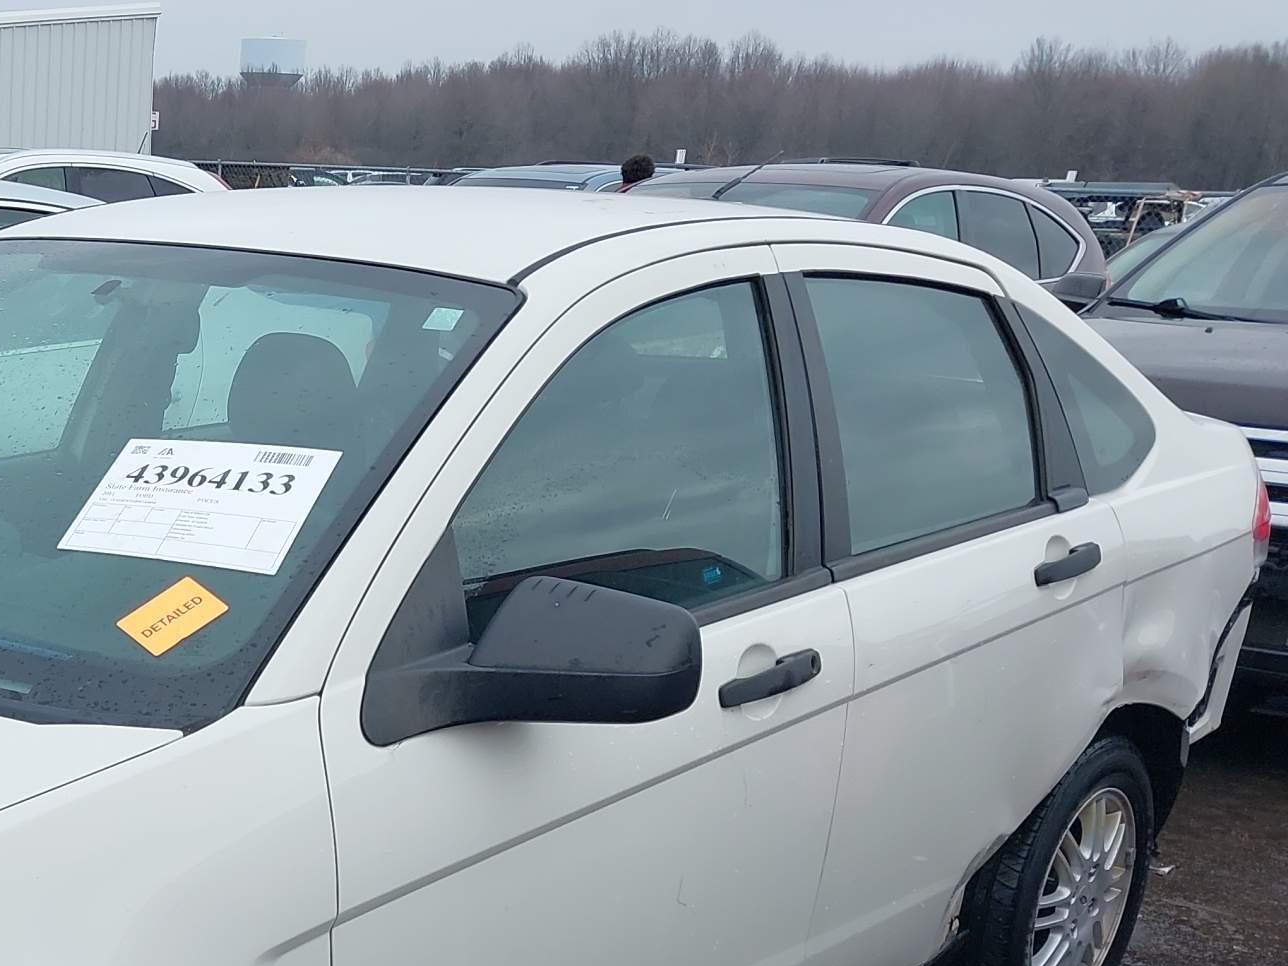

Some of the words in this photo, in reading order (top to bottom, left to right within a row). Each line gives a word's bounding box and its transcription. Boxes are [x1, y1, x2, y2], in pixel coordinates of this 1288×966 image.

[105, 483, 127, 491] State
[128, 484, 151, 492] Farm
[152, 485, 194, 495] Insurance
[126, 463, 296, 496] 43964133
[141, 595, 203, 639] DETAILED
